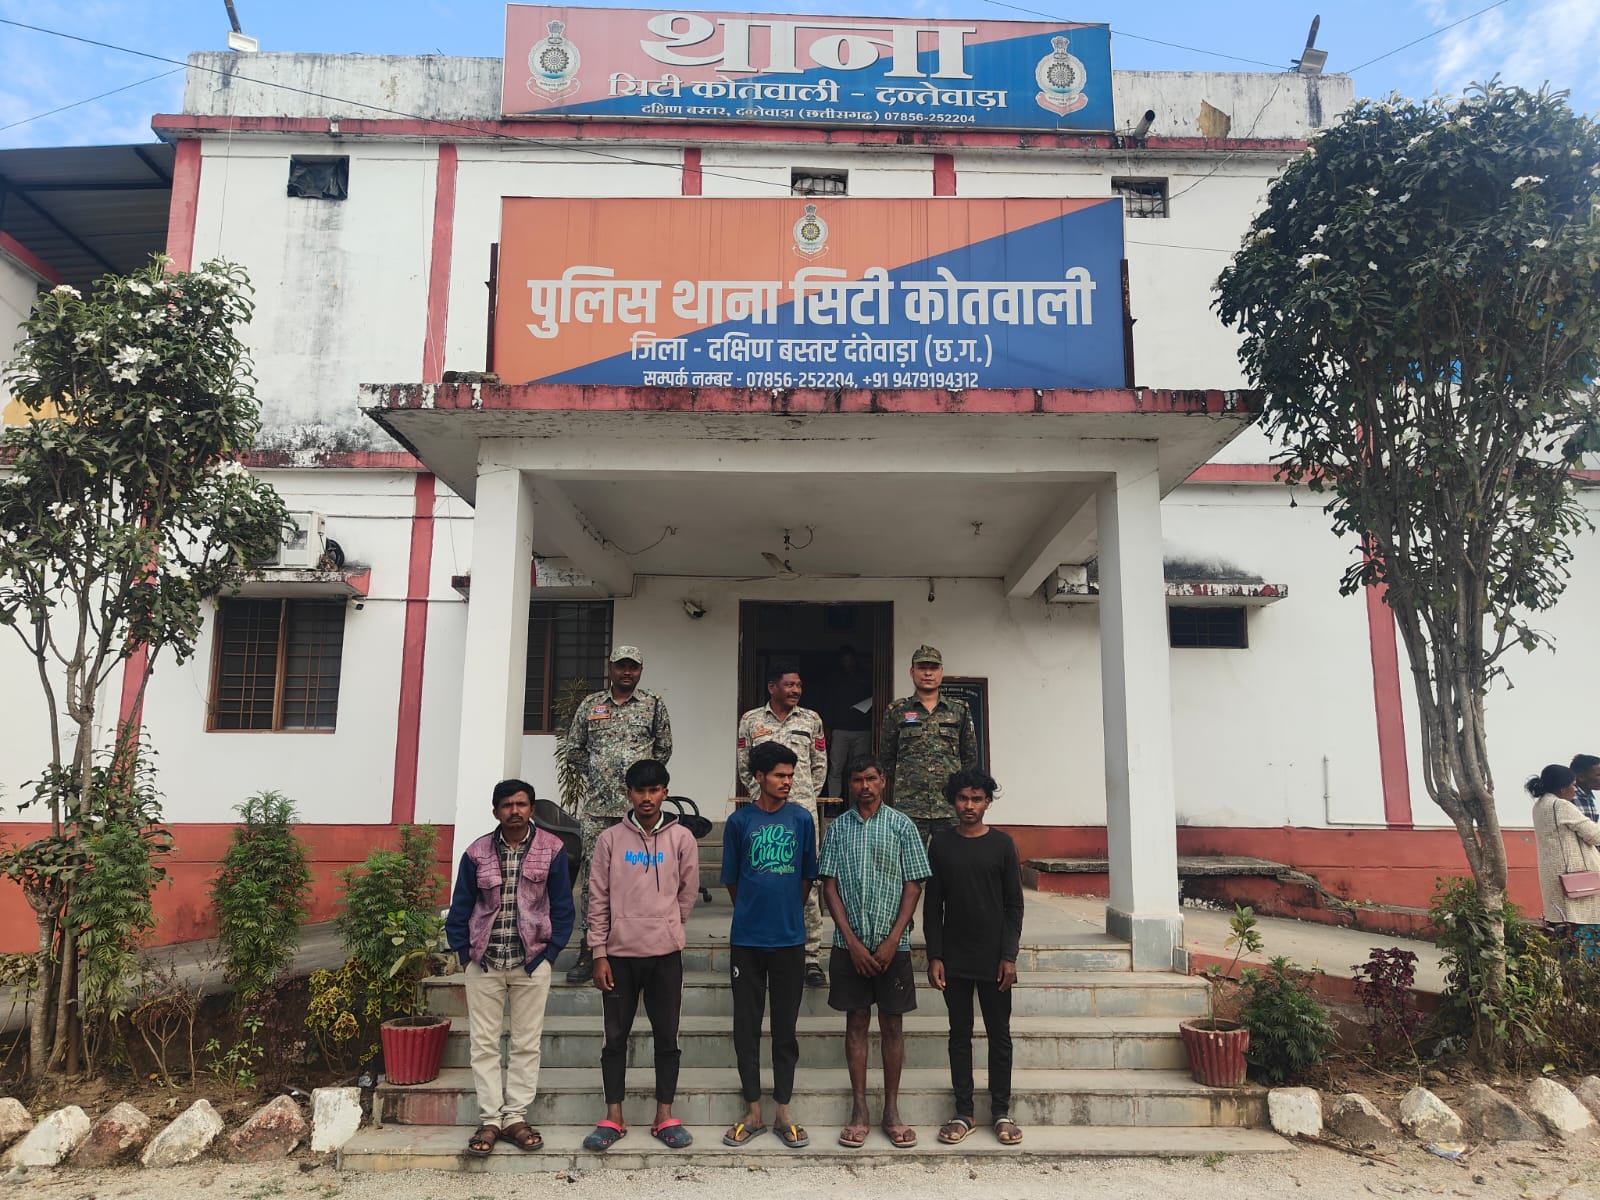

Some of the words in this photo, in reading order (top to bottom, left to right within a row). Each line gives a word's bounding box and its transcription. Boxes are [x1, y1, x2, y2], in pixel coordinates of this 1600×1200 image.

[639, 13, 976, 80] थाना
[608, 72, 684, 98] सिटी
[691, 75, 841, 103] कोतवाली
[875, 81, 1009, 111] दन्तेवाड़ा
[641, 102, 682, 115] दक्षिण
[884, 112, 976, 124] 07856-252204
[526, 265, 662, 339] पुलिस
[672, 280, 782, 325] थाना
[789, 266, 894, 325] सिटी
[901, 266, 1097, 325] कोतवाली
[630, 330, 689, 361] जिला
[707, 331, 774, 362] दक्षिण
[777, 339, 840, 363] बस्तर
[842, 332, 919, 368] दंतेवाड़ा
[924, 334, 993, 368] (छ.ग.)
[643, 367, 689, 387] सम्पर्क
[691, 371, 733, 387] नम्बर
[746, 371, 858, 388] 07856-252204,
[862, 372, 890, 388] +91
[893, 372, 978, 388] 9479194312
